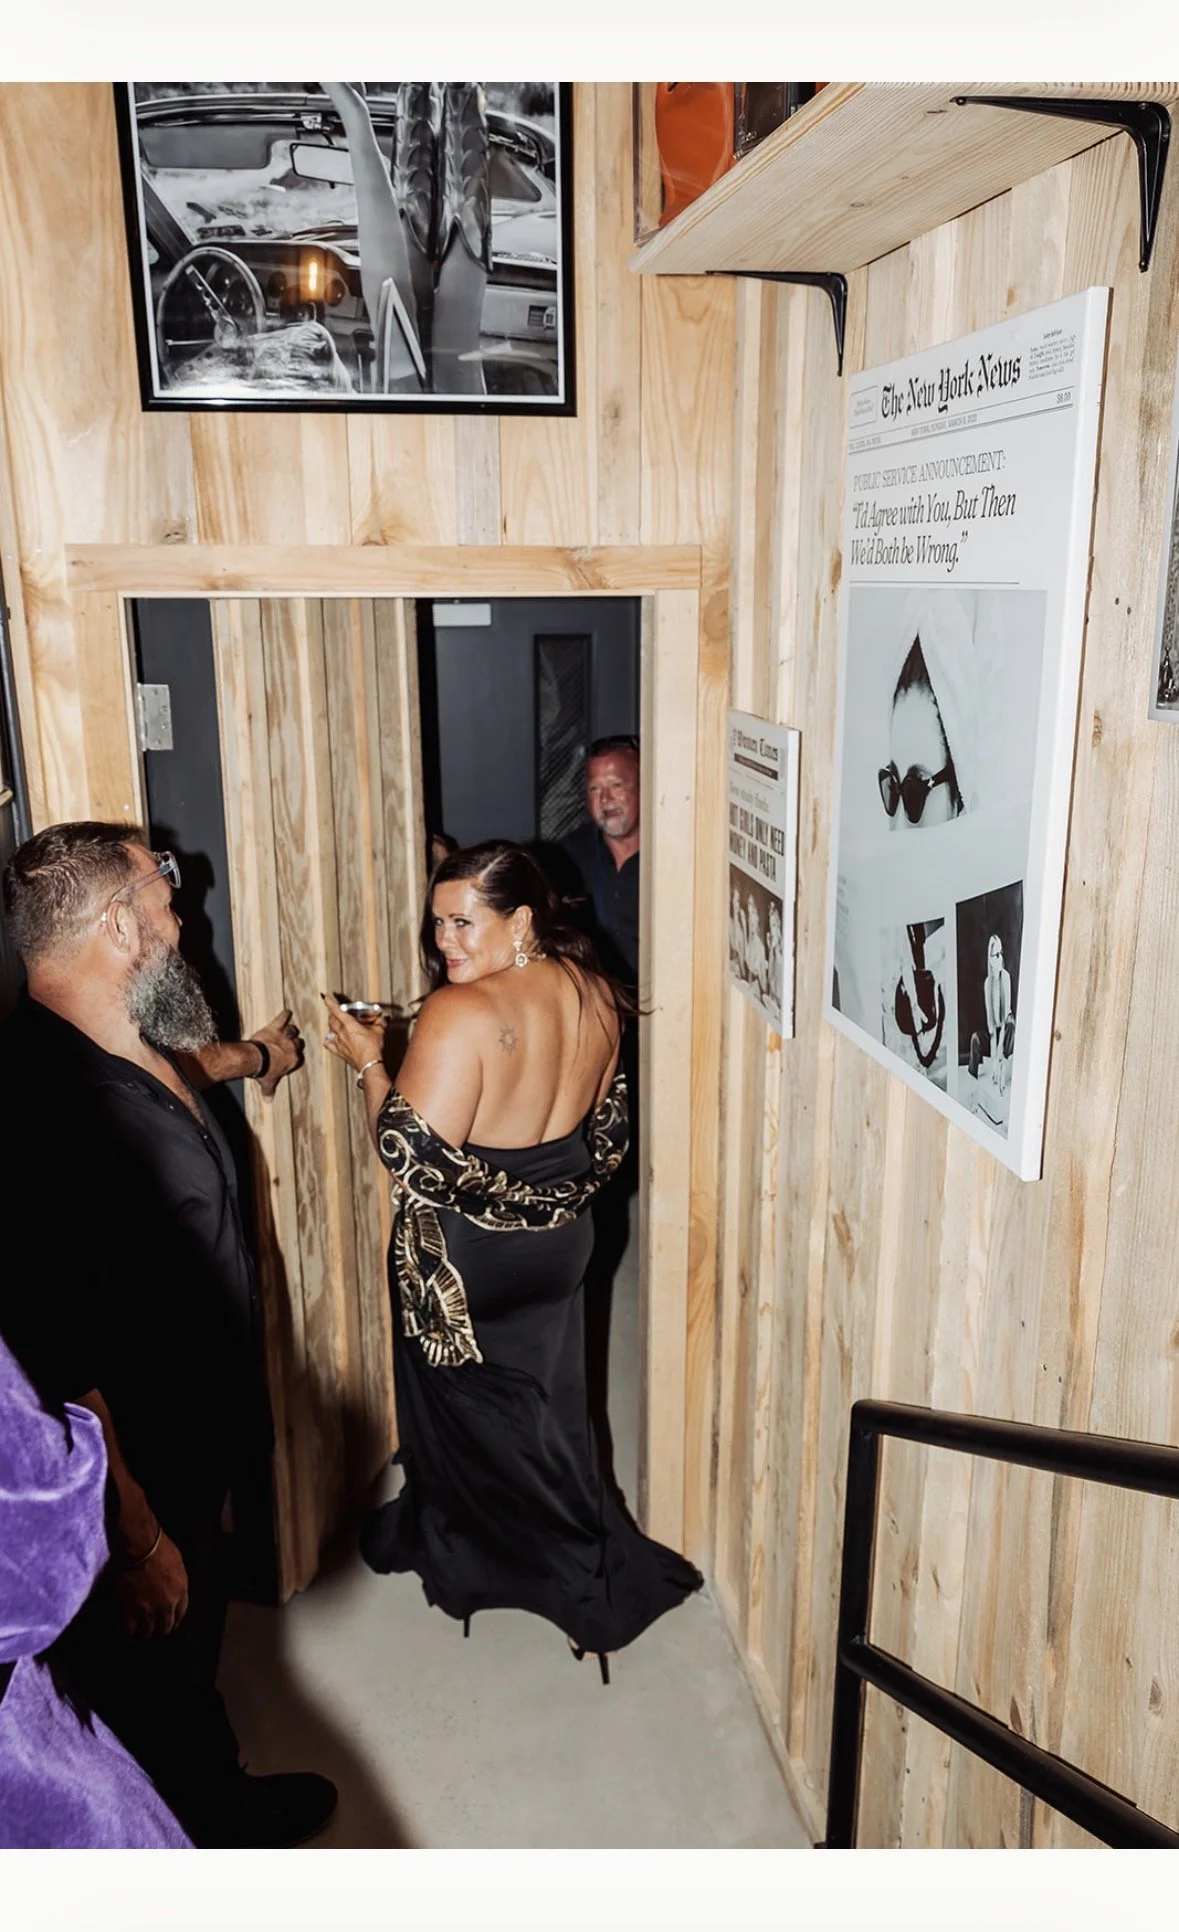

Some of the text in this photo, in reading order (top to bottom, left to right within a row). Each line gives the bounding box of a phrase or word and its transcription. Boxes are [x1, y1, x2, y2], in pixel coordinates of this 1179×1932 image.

[881, 382, 904, 421] The
[906, 377, 936, 417] New
[938, 359, 975, 416] York
[977, 353, 1022, 398] News
[853, 450, 1006, 492] PUBLIC SERVICE ANNOUNCEMENT:
[867, 501, 898, 536] Agree
[900, 494, 924, 525] with
[926, 493, 951, 528] You,
[953, 489, 979, 521] But
[980, 484, 1016, 519] Then
[874, 536, 900, 566] Both
[901, 536, 914, 564] be
[770, 824, 785, 857] NEED
